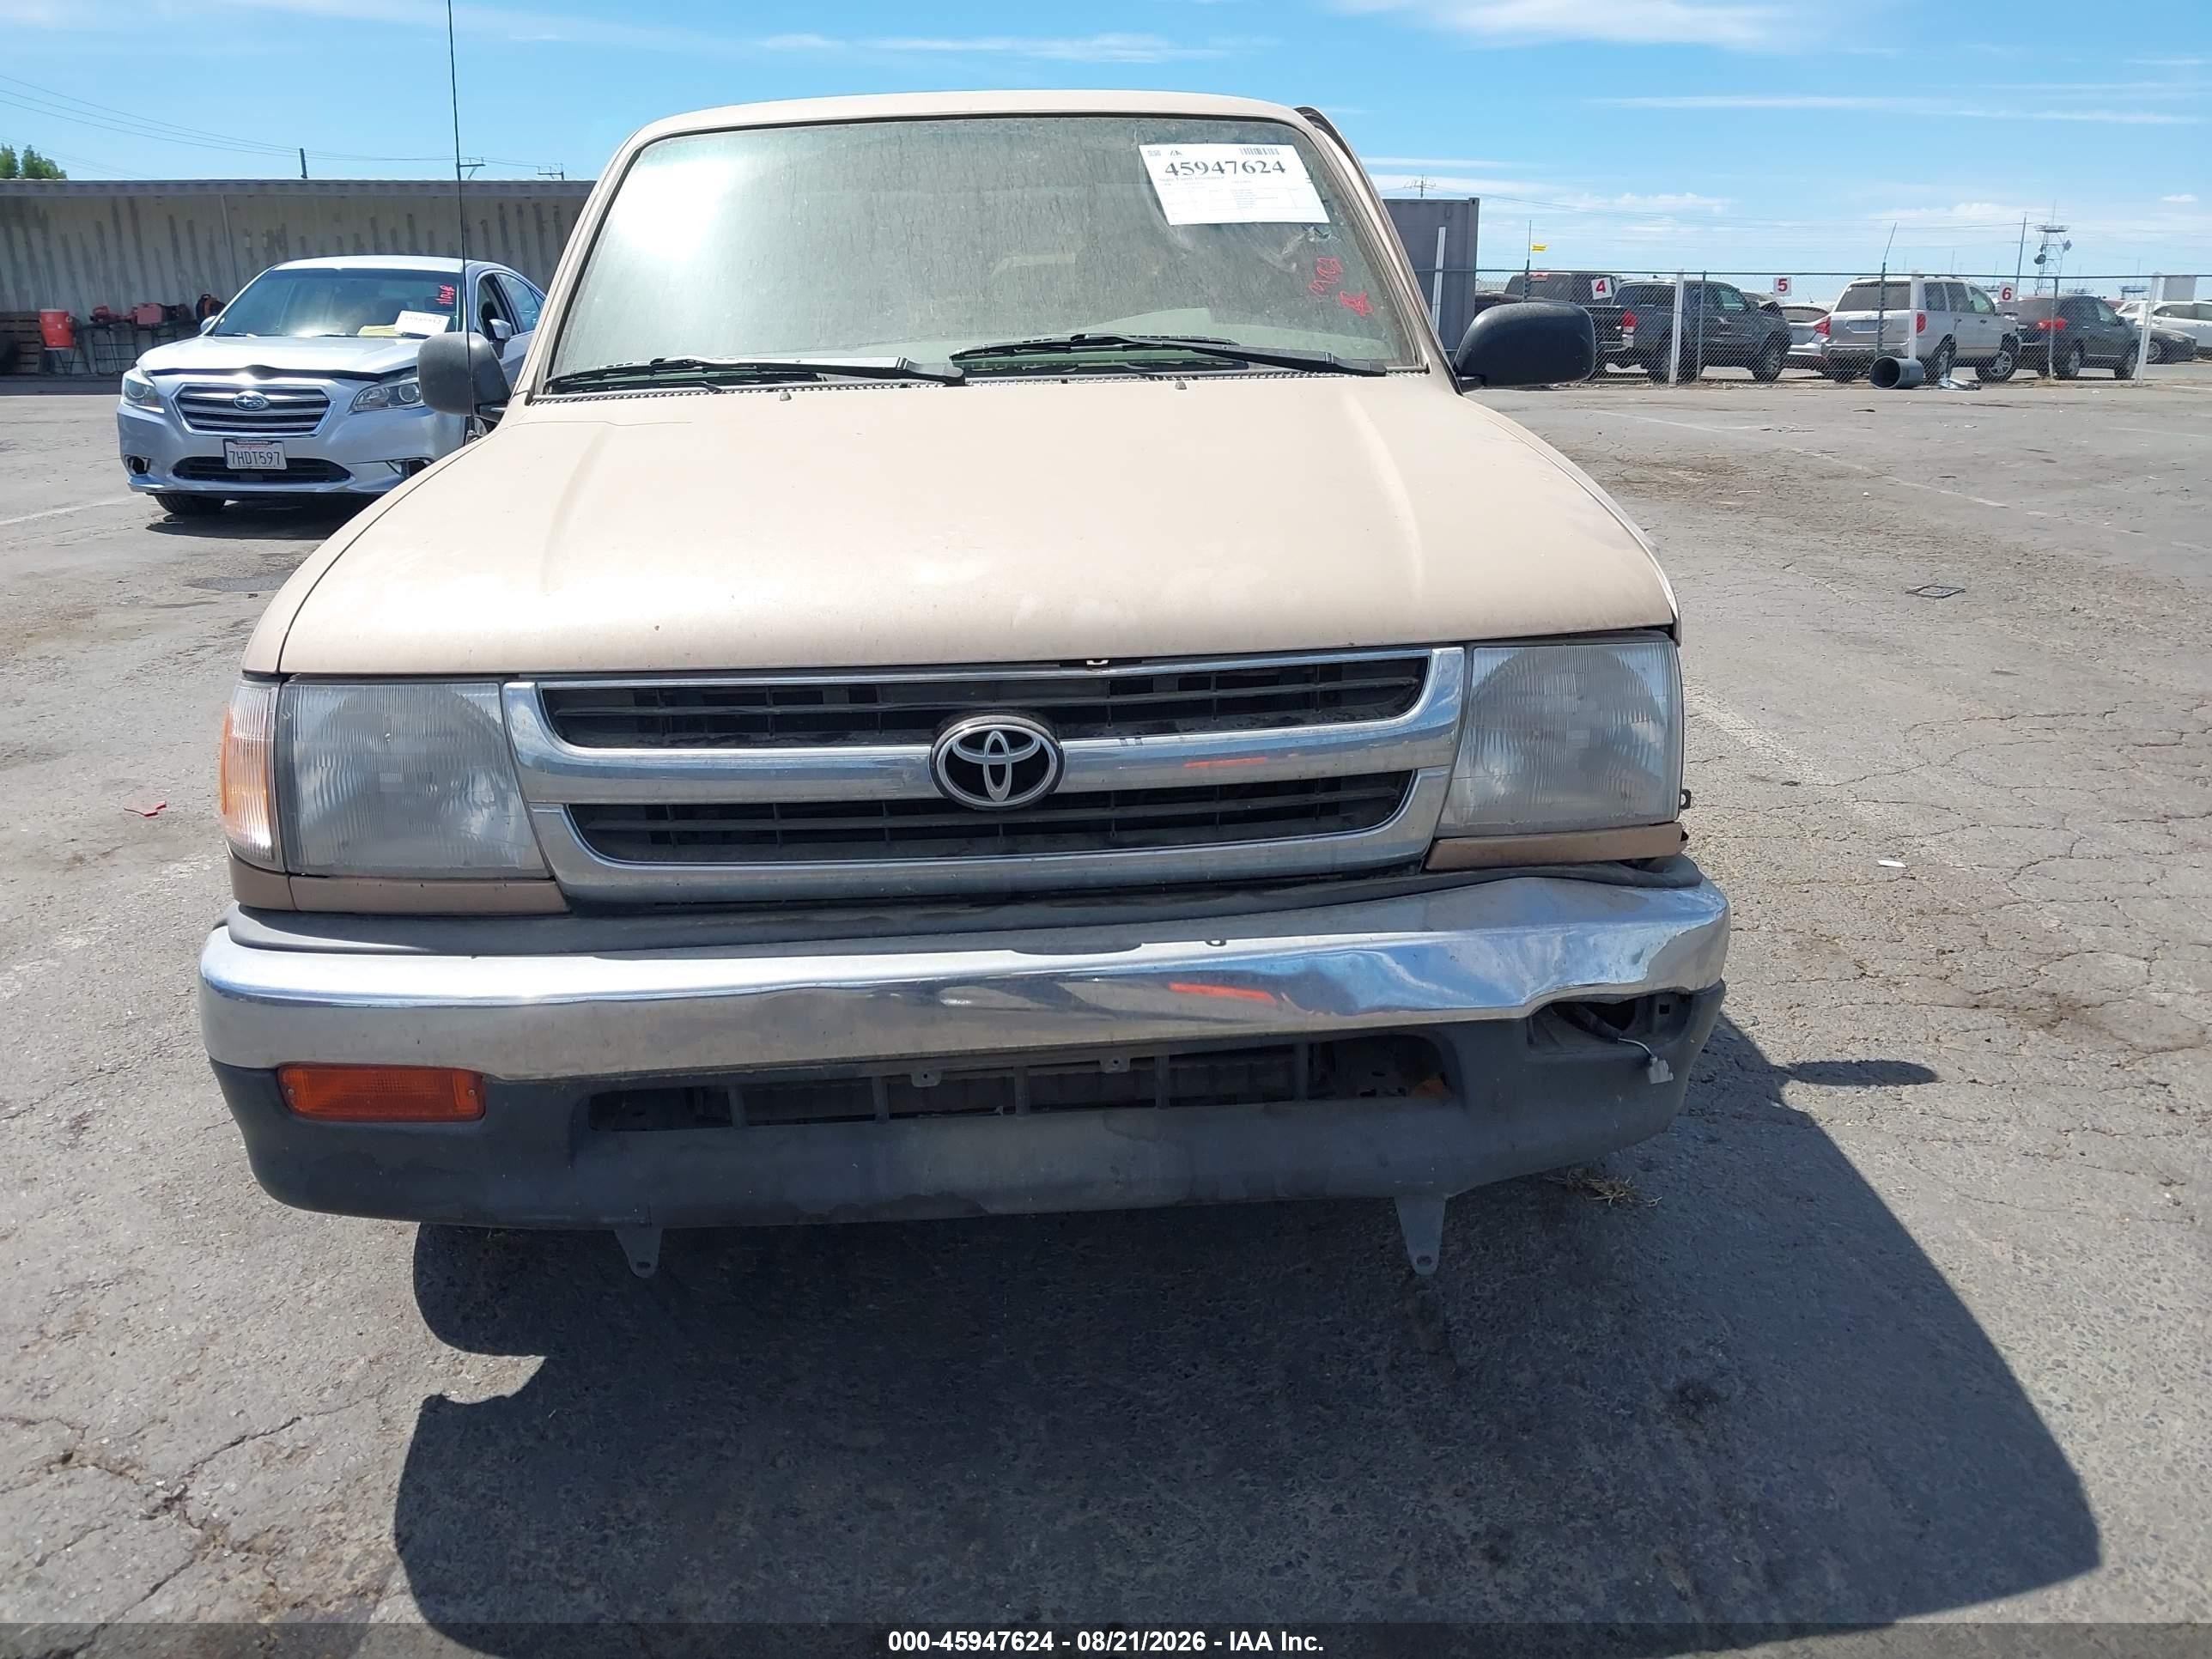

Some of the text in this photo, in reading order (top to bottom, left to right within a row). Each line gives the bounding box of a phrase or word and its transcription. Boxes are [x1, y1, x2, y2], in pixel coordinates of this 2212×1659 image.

[1165, 161, 1285, 176] 45947624
[1595, 280, 1607, 294] 4
[1778, 278, 1789, 292] 5
[2002, 287, 2012, 301] 6
[228, 451, 280, 466] 7HDT597
